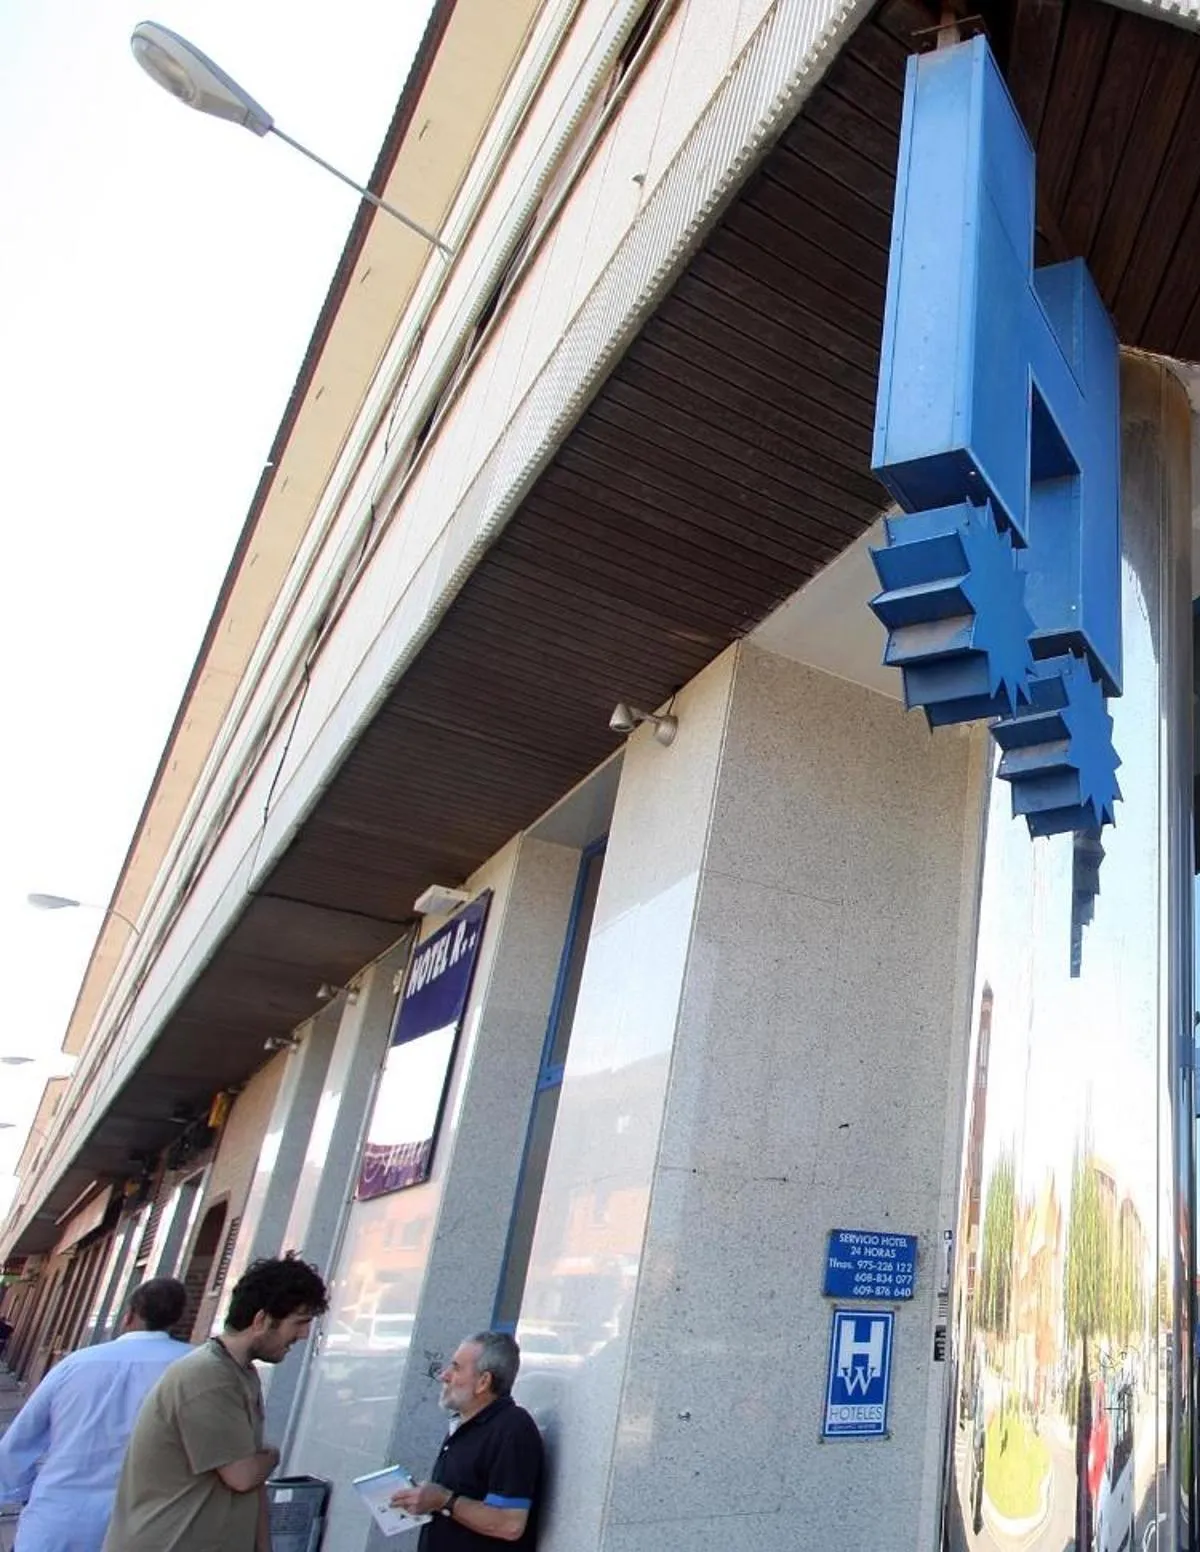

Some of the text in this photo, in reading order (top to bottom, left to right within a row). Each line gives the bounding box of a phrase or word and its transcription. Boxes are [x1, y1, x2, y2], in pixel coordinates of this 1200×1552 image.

[406, 931, 452, 999] HOTEL
[839, 1233, 907, 1248] SERVICIO HOTEL
[850, 1246, 896, 1258] 24 HORAS
[857, 1260, 893, 1271] 975-226
[896, 1262, 913, 1273] 122
[895, 1274, 913, 1285] 077
[852, 1285, 912, 1297] 609-876 640
[829, 1405, 882, 1421] HOTELES
